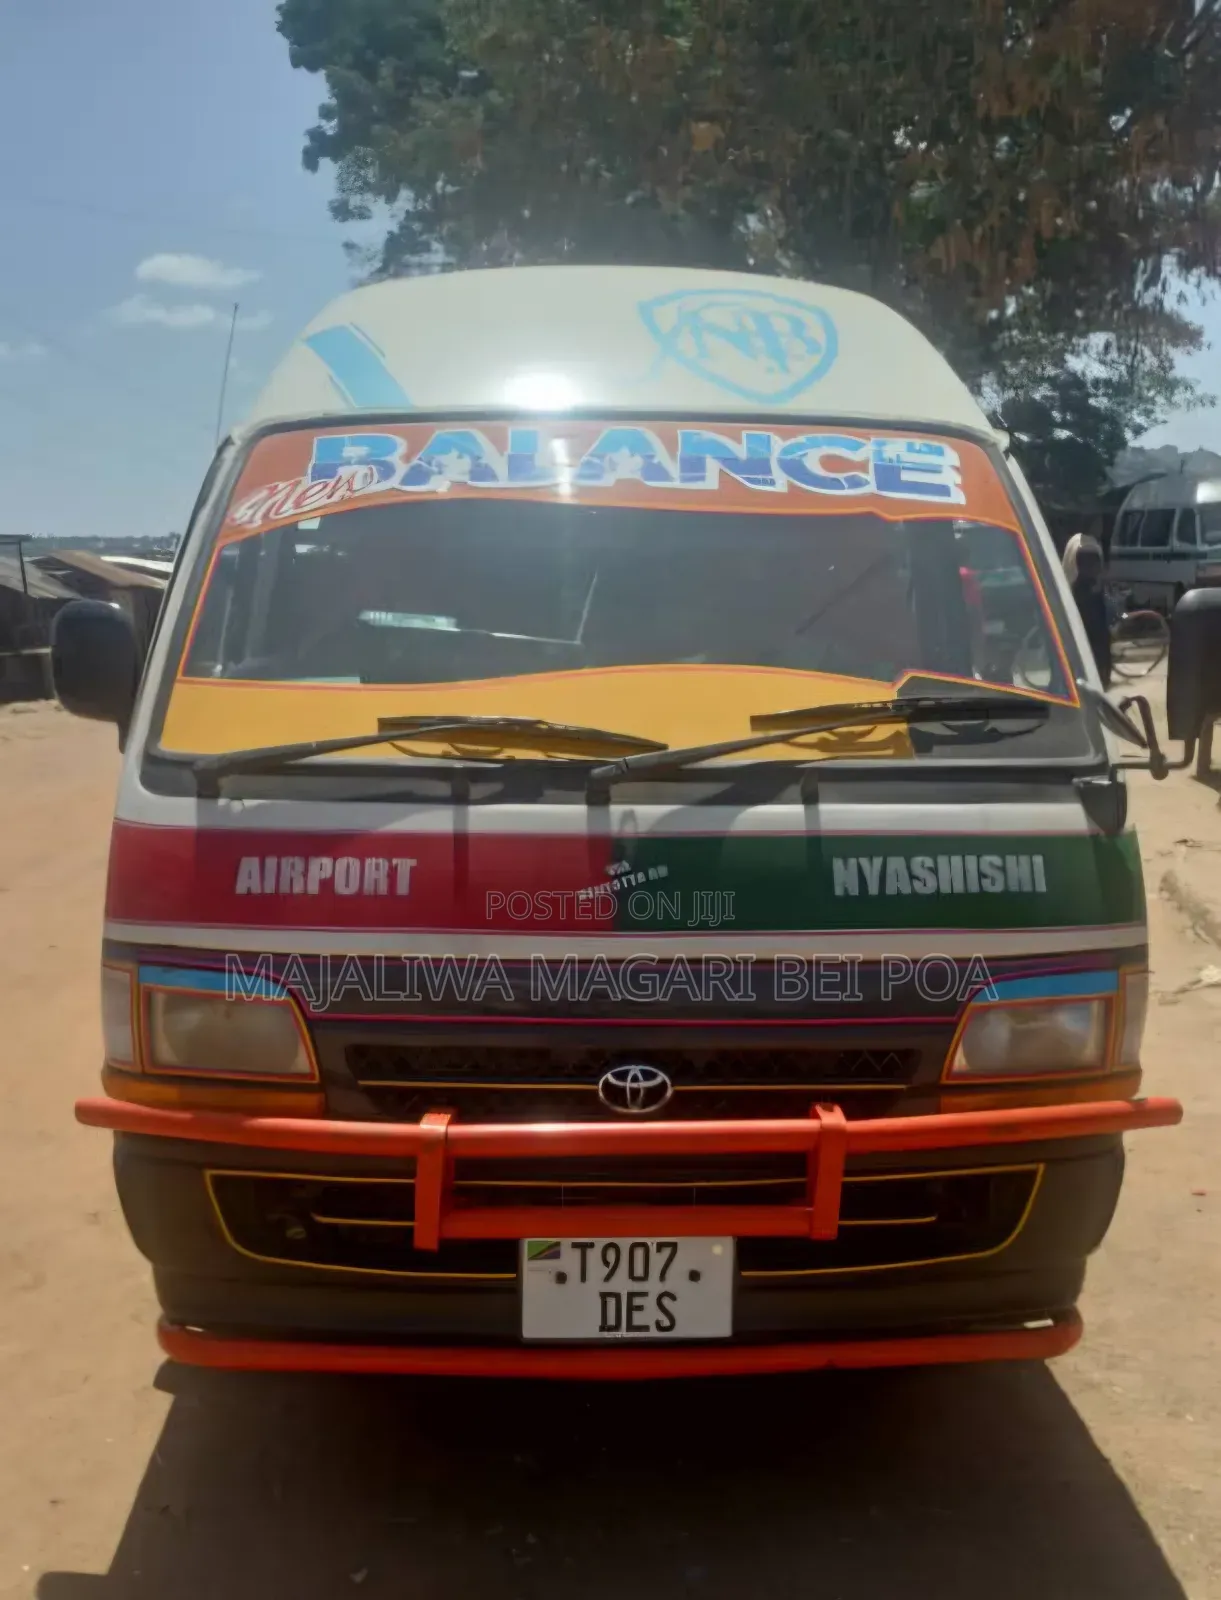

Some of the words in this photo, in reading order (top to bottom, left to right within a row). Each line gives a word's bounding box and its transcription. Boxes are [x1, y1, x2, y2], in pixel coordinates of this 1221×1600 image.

[306, 424, 967, 505] BALANCE
[235, 856, 417, 896] AIRPORT
[832, 854, 1048, 896] NYASHISHI
[570, 1241, 678, 1284] T907
[599, 1291, 678, 1333] DES
